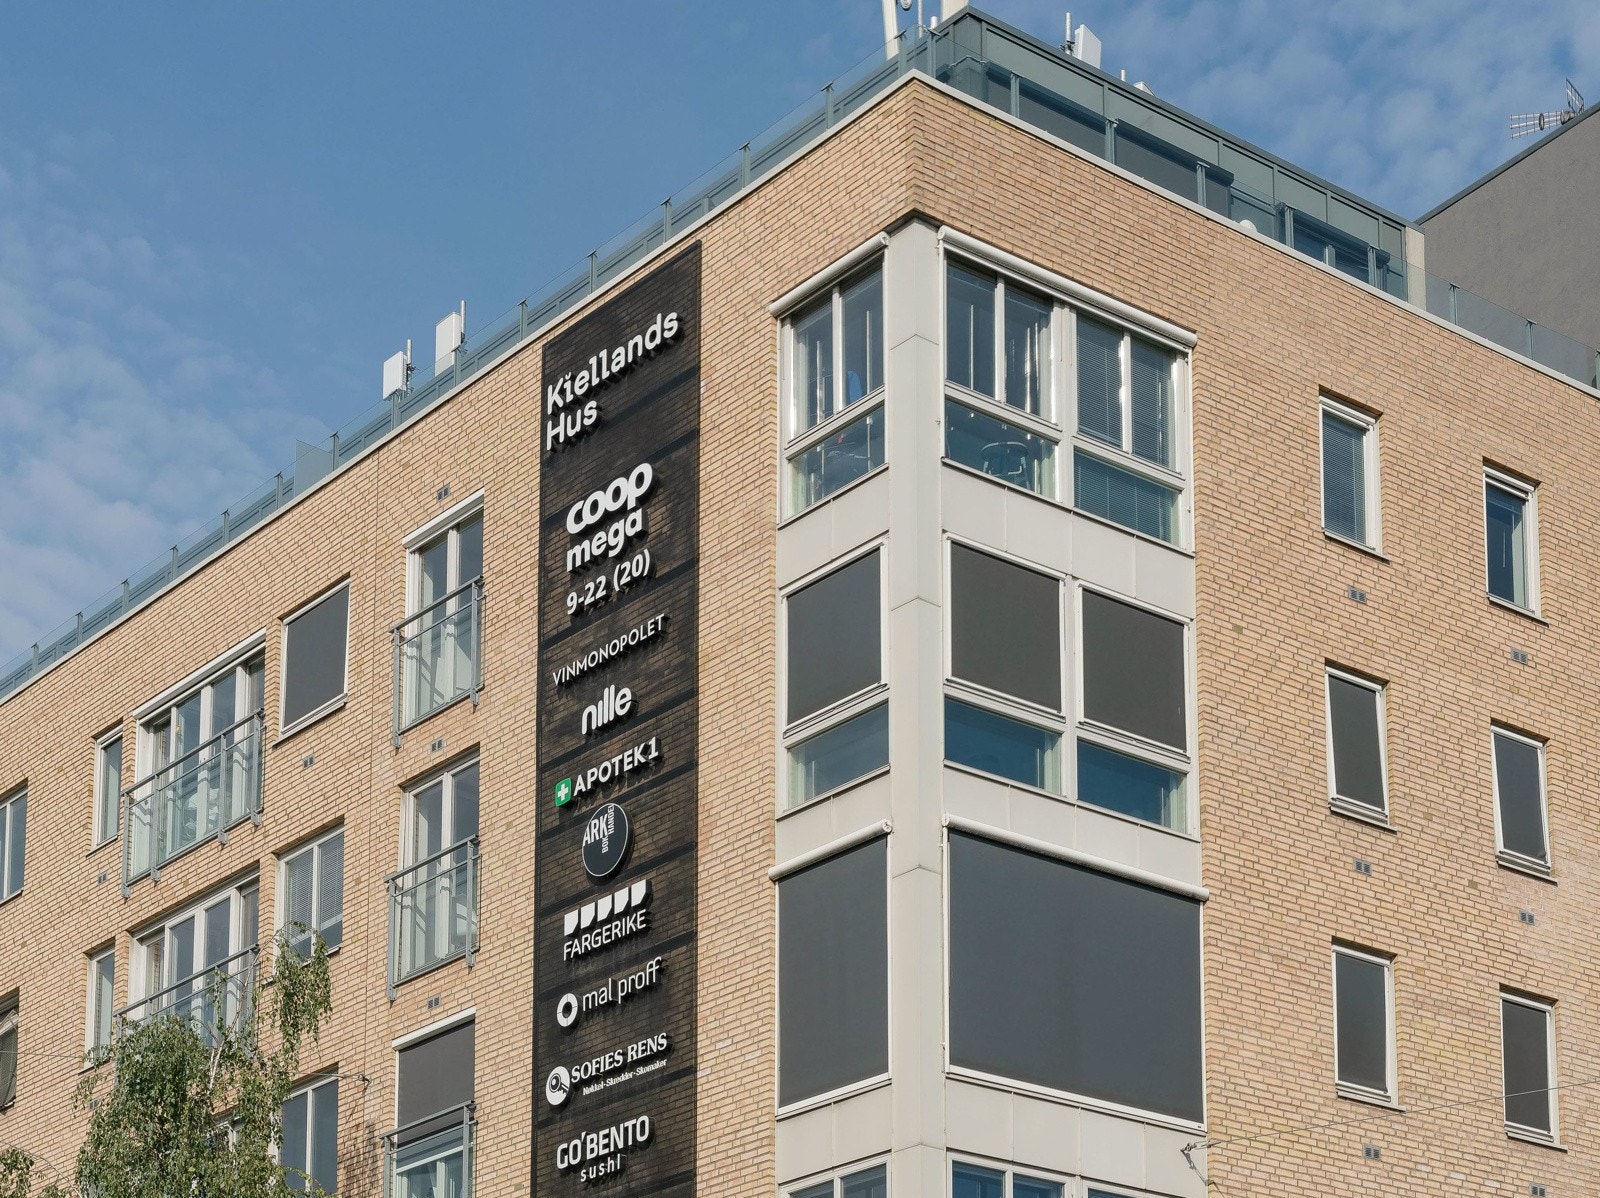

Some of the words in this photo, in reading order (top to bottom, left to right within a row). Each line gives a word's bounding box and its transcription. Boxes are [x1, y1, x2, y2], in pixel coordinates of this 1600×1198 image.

[547, 312, 679, 415] Kiellands
[546, 400, 598, 450] Hus
[566, 463, 653, 535] coop
[566, 508, 643, 572] mega
[566, 576, 606, 615] 9-22
[613, 549, 651, 592] (20)
[553, 614, 666, 686] VINMONOPOLET
[581, 684, 632, 735] nille
[582, 813, 608, 847] ARK
[563, 909, 647, 961] FARGERIKE
[582, 978, 613, 1012] mal
[618, 956, 662, 1005] proff
[571, 1049, 624, 1083] SOFIES
[627, 1032, 668, 1062] RENS
[580, 1153, 621, 1182] sushi
